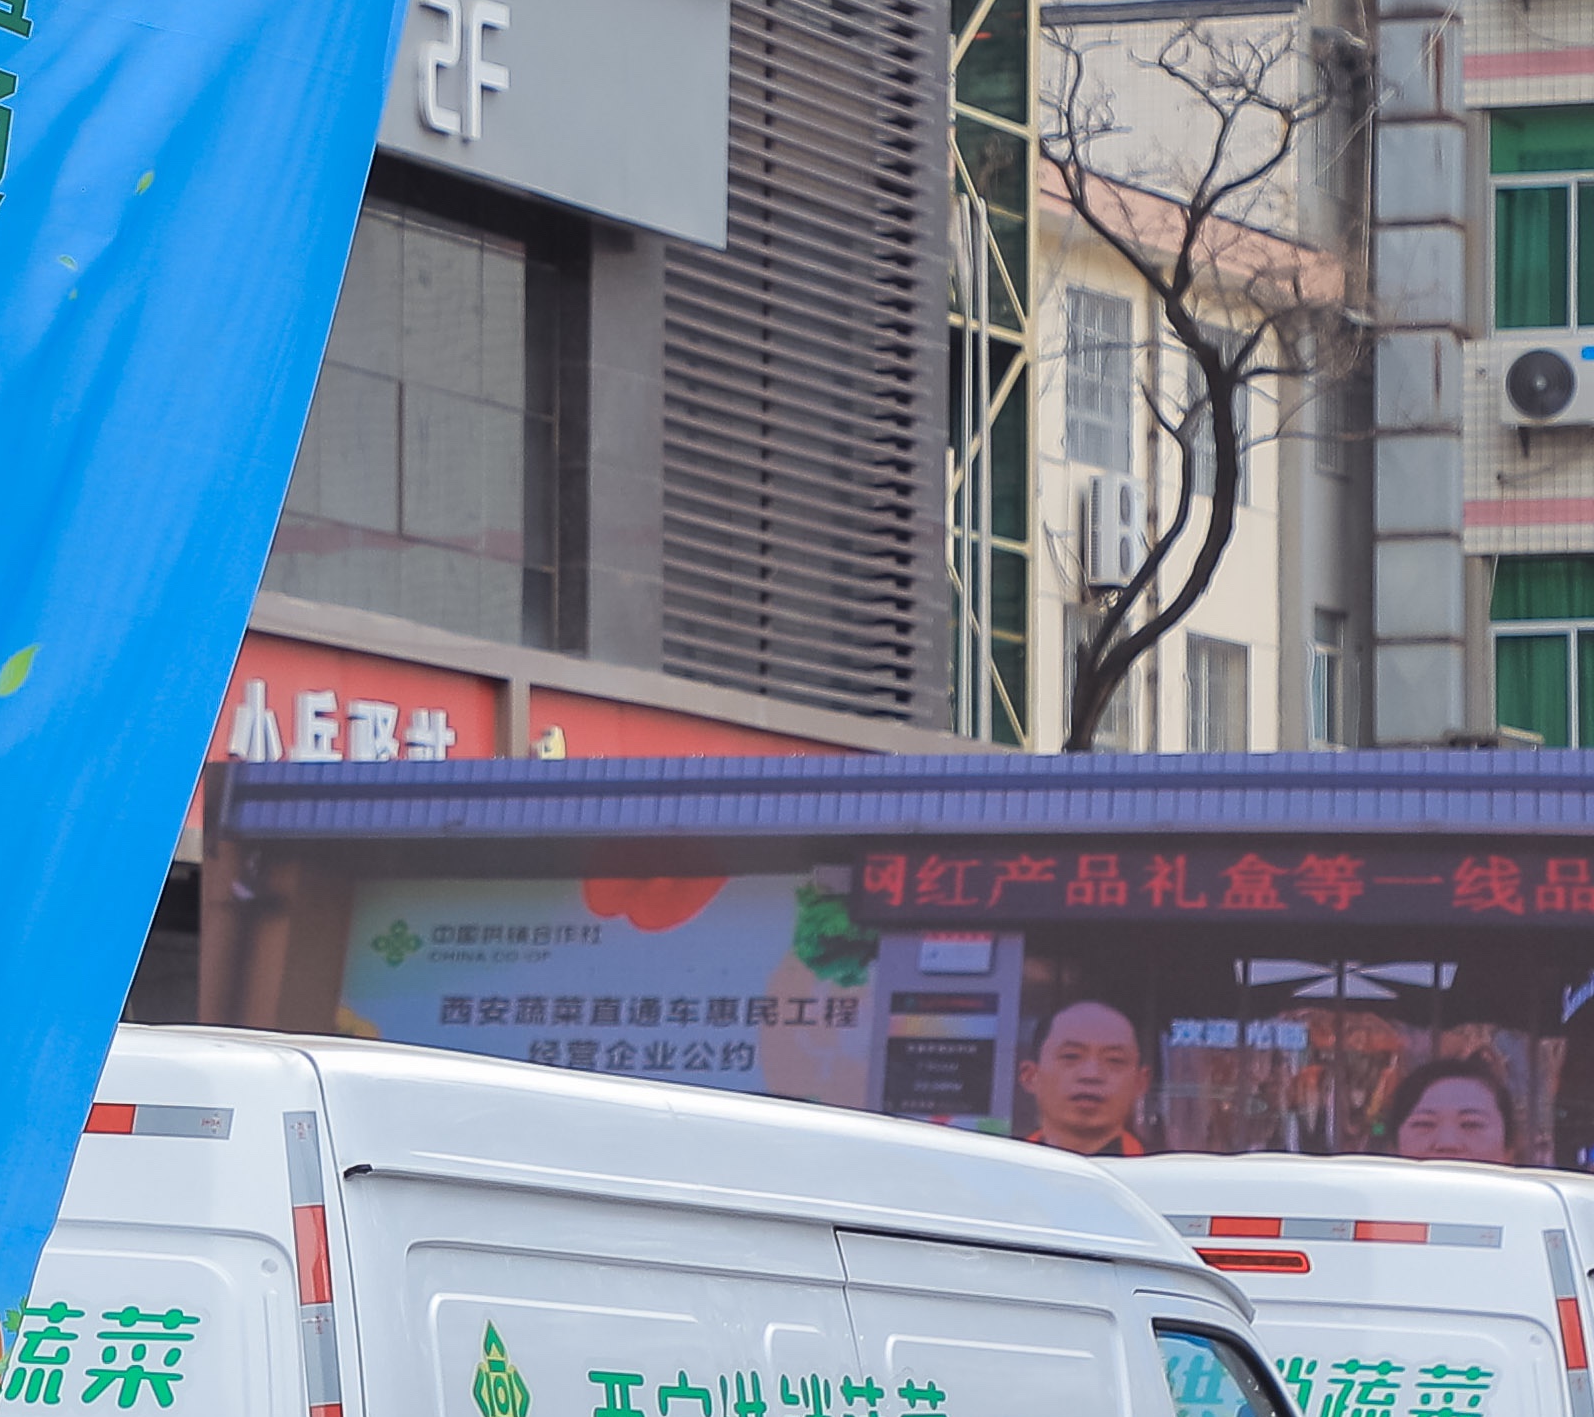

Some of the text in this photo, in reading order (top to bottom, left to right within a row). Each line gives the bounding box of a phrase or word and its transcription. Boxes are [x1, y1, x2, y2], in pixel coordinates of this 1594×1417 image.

[439, 996, 860, 1029] 西安蔬菜直通车惠民工程
[529, 1039, 757, 1073] 经营企业公约
